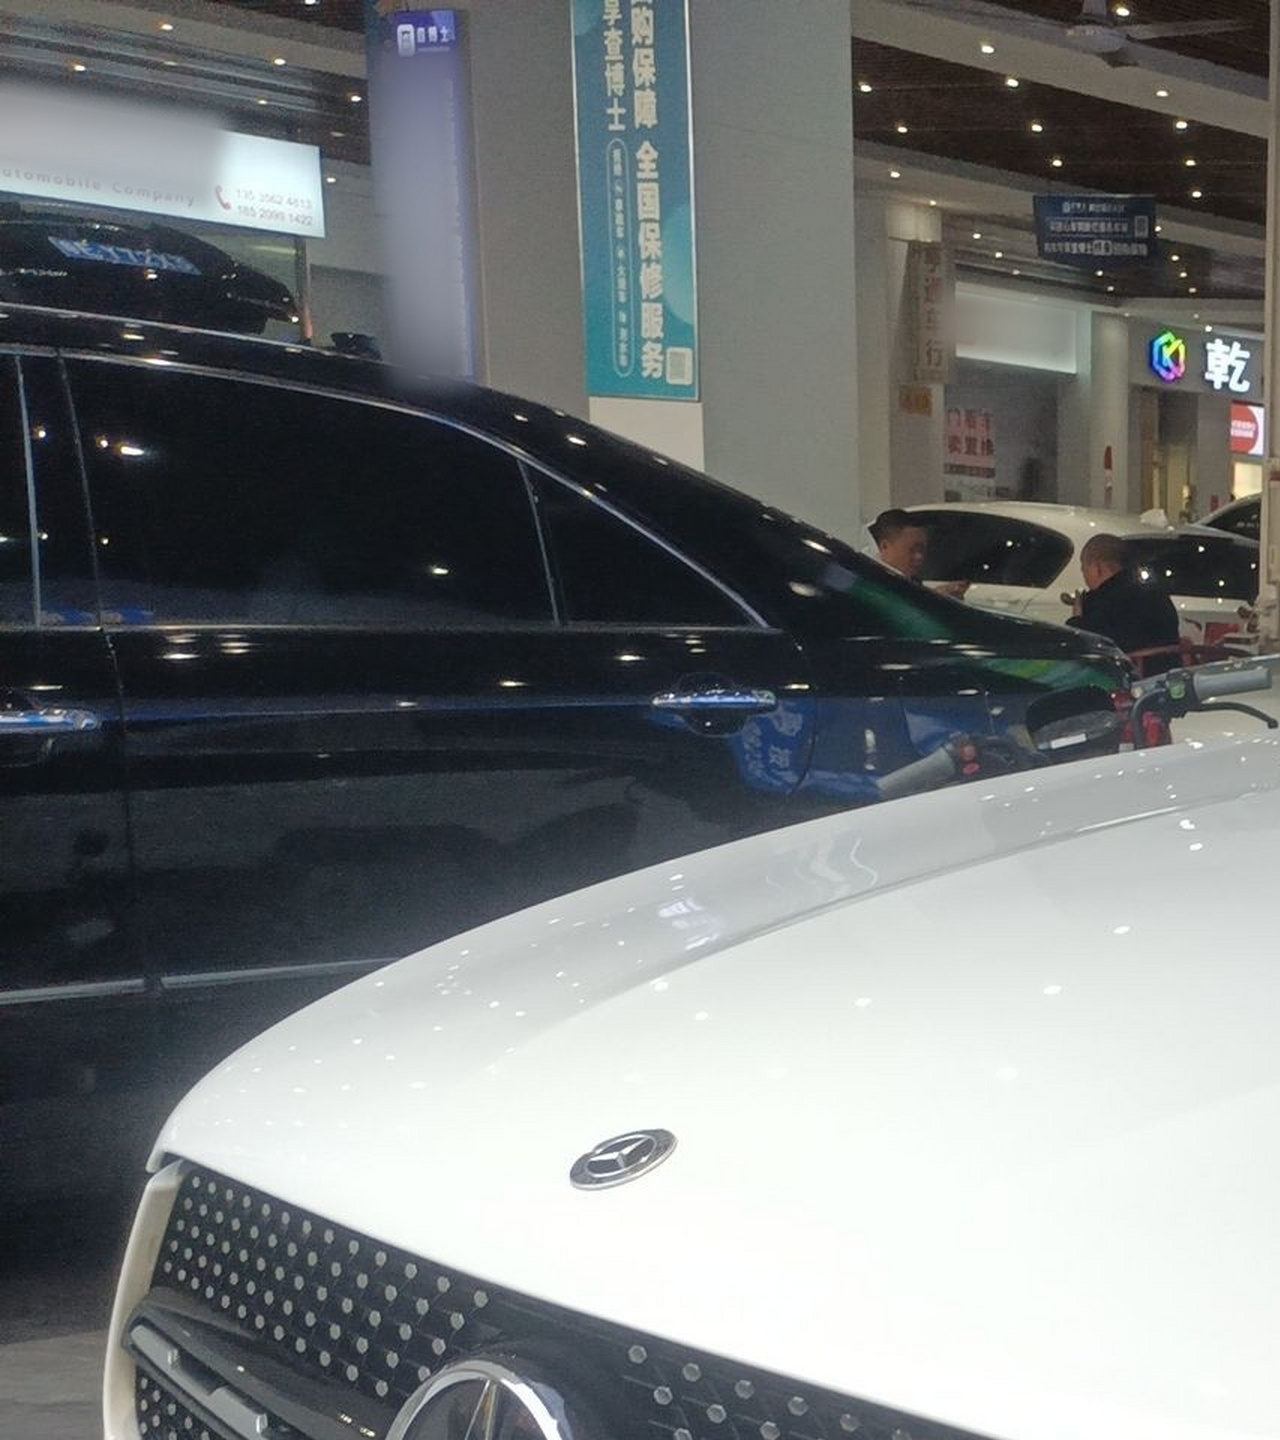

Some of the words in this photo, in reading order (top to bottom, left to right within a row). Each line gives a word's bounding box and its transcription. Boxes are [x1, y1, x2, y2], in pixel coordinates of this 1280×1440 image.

[630, 0, 658, 129] 购保障
[0, 167, 101, 190] utomobile
[636, 140, 665, 379] 全国保修服务
[1204, 338, 1251, 393] 乾
